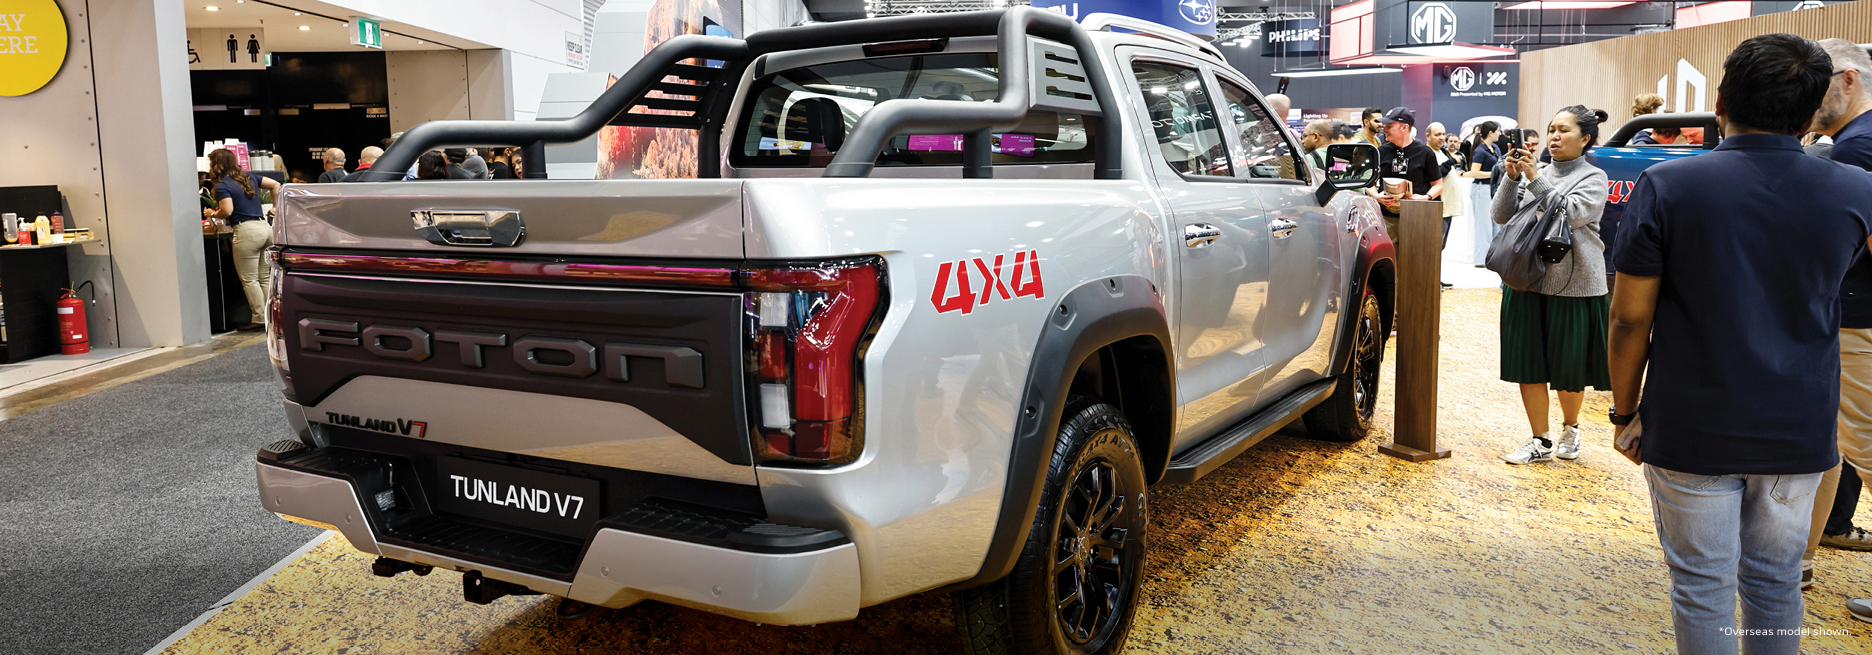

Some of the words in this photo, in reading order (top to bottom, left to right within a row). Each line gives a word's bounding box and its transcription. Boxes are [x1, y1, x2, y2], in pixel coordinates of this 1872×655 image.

[1268, 28, 1320, 43] PHILIPS
[1412, 3, 1456, 43] MG
[1451, 67, 1475, 90] MG
[1607, 180, 1635, 204] 4X
[929, 248, 1045, 316] 4X4
[299, 317, 705, 389] FOTON
[325, 411, 396, 433] TUNLAND
[397, 418, 427, 438] V7
[450, 474, 551, 514] TUNLAND
[554, 492, 584, 520] V7
